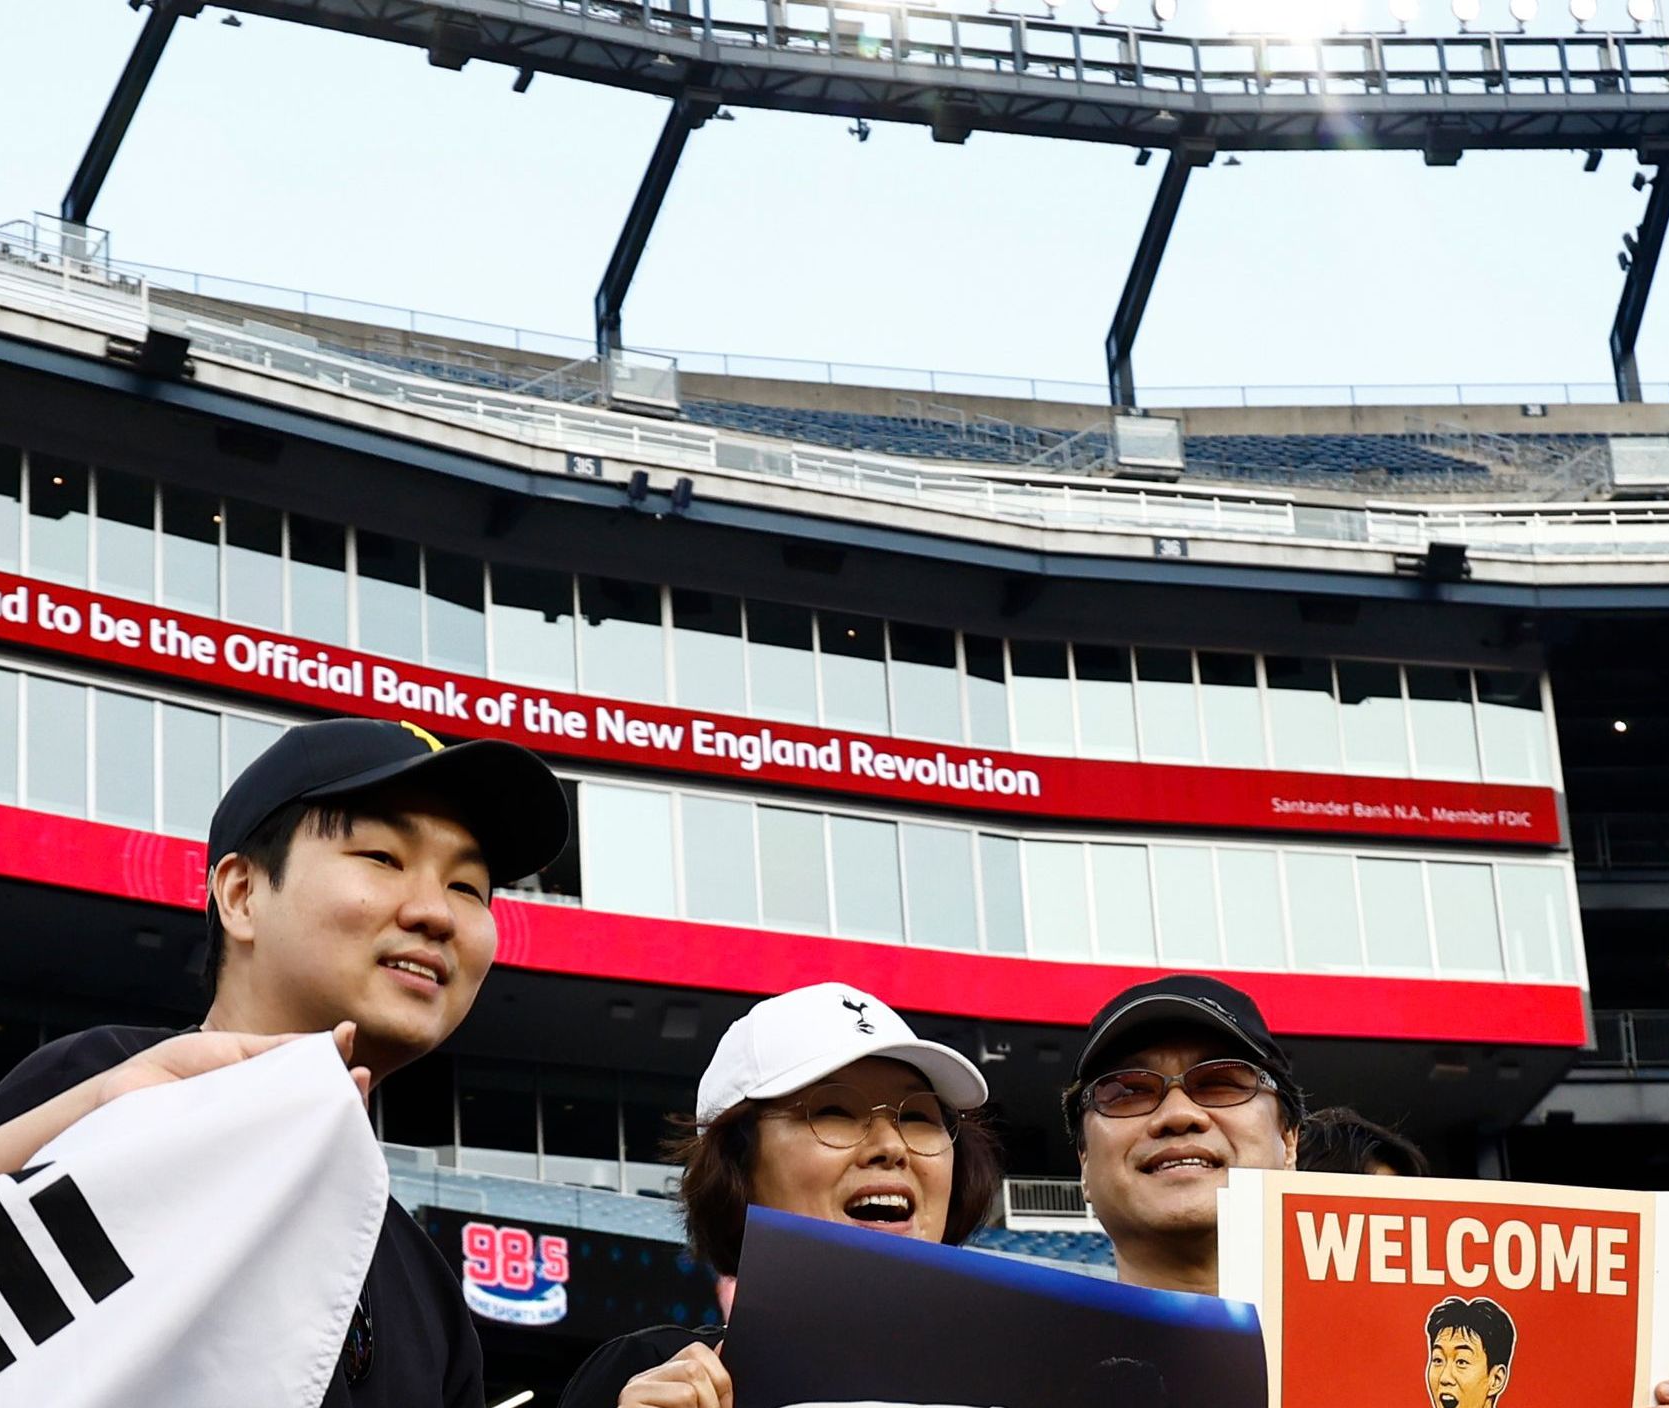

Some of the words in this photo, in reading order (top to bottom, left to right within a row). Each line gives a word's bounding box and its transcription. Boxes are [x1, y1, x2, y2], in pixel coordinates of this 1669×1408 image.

[37, 592, 81, 636] to
[90, 602, 141, 648] be
[149, 618, 216, 665] the
[224, 633, 363, 697] Official
[372, 665, 469, 720] Bank
[475, 691, 517, 727] of
[523, 697, 587, 739] the
[596, 706, 684, 751] New
[691, 719, 842, 772] England
[849, 740, 1041, 797] Revolution
[1271, 797, 1350, 817] Santander
[1352, 801, 1392, 819] Bank
[1432, 807, 1495, 825] Member
[1497, 810, 1532, 828] FDIC
[1295, 1210, 1629, 1296] WELCOME
